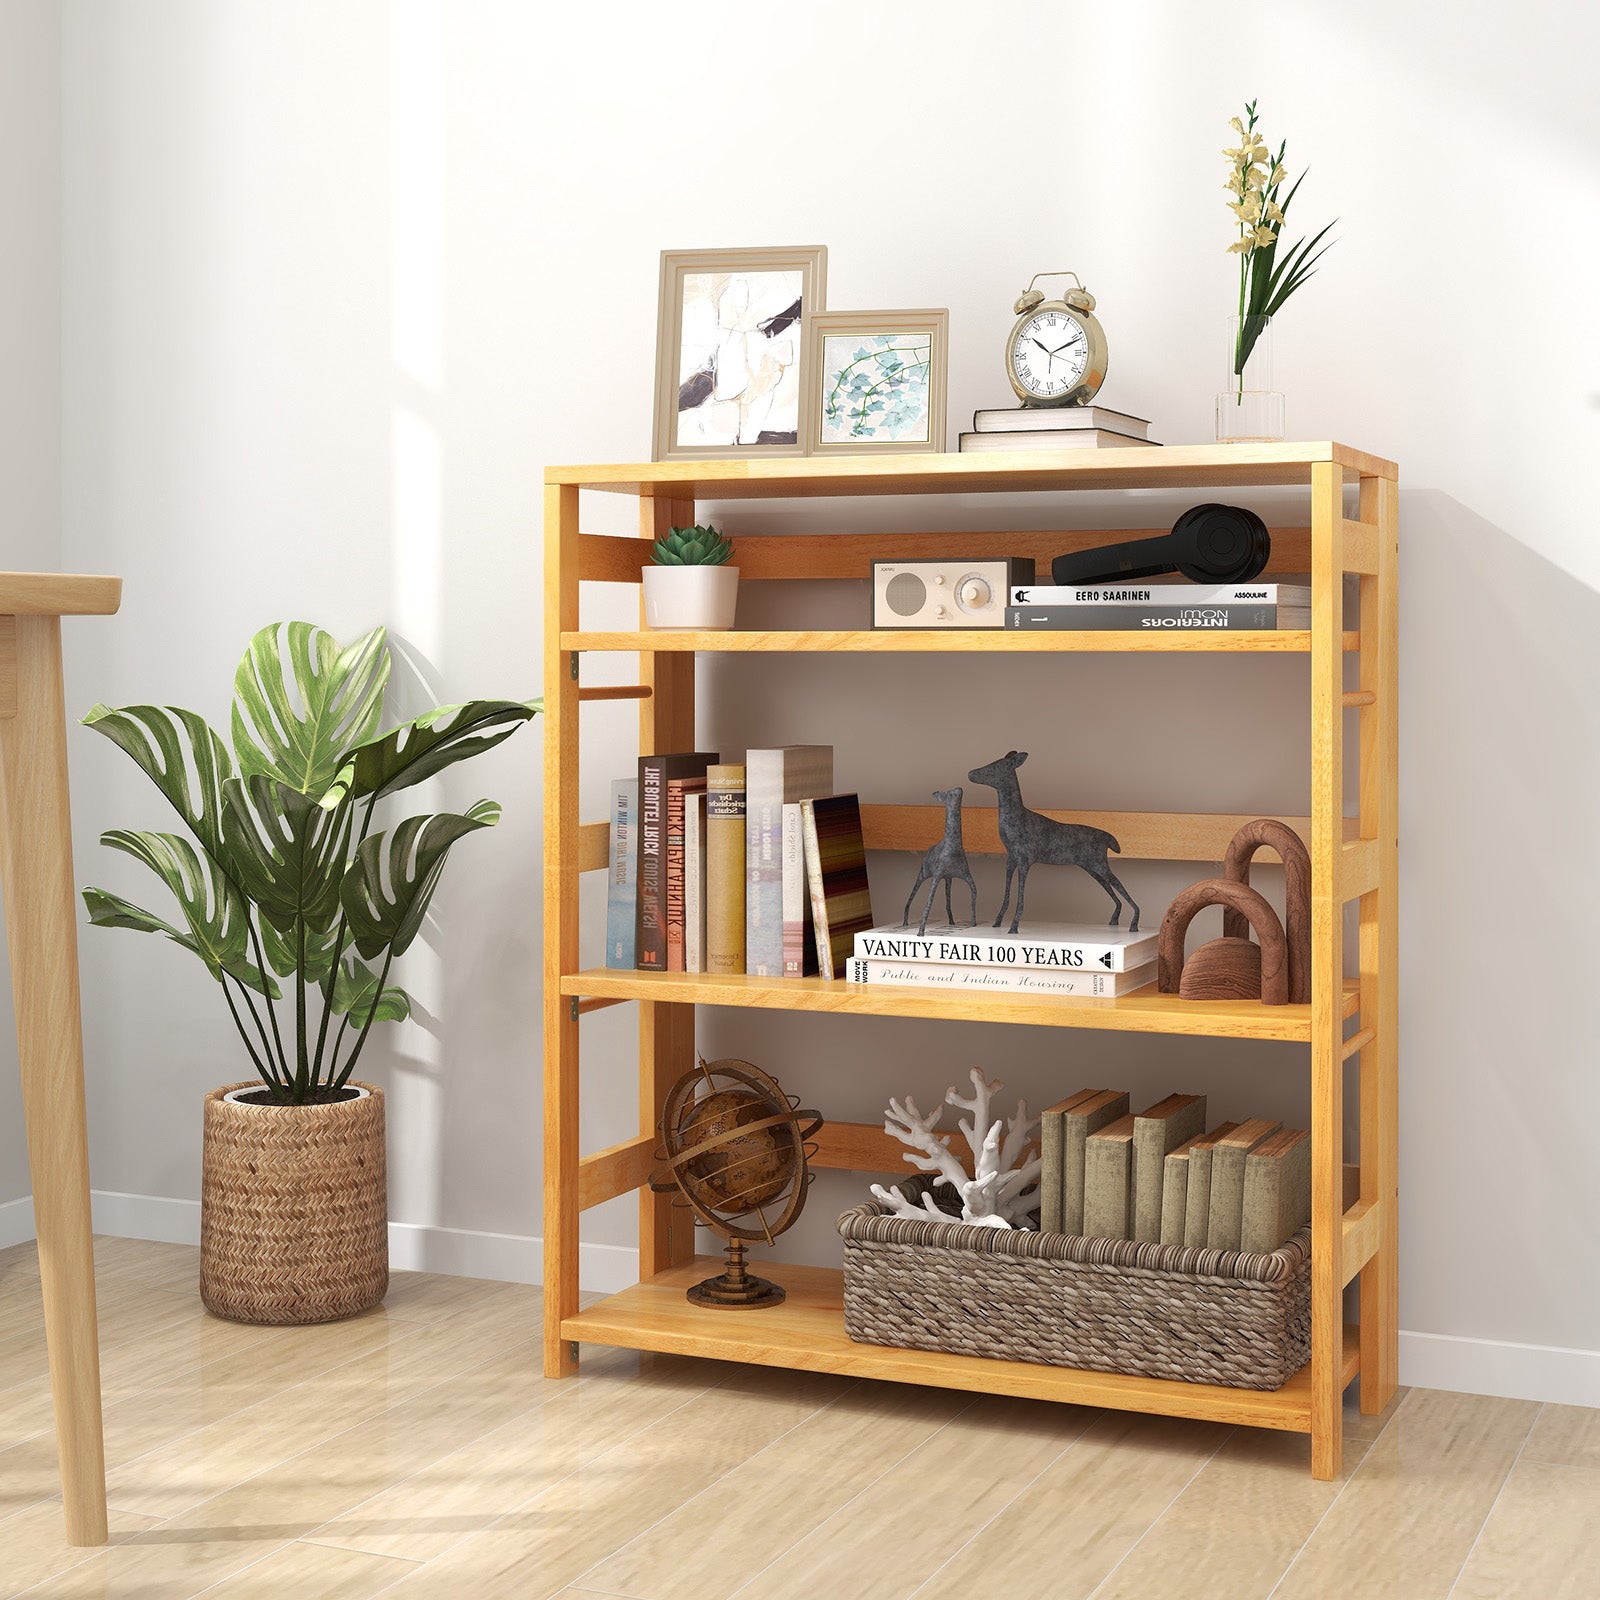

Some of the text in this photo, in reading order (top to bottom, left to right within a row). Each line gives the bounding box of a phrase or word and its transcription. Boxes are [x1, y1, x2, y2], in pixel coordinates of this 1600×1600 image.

[1046, 382, 1053, 390] VI
[1075, 590, 1151, 601] EERO SAARINEN
[1234, 591, 1268, 599] ASSOULINE
[1180, 609, 1229, 618] NOW!
[1142, 618, 1229, 627] INTERIORS
[862, 938, 1083, 967] VANITY FAIR 100 YEARS
[880, 968, 1075, 993] Public and Indian Housing
